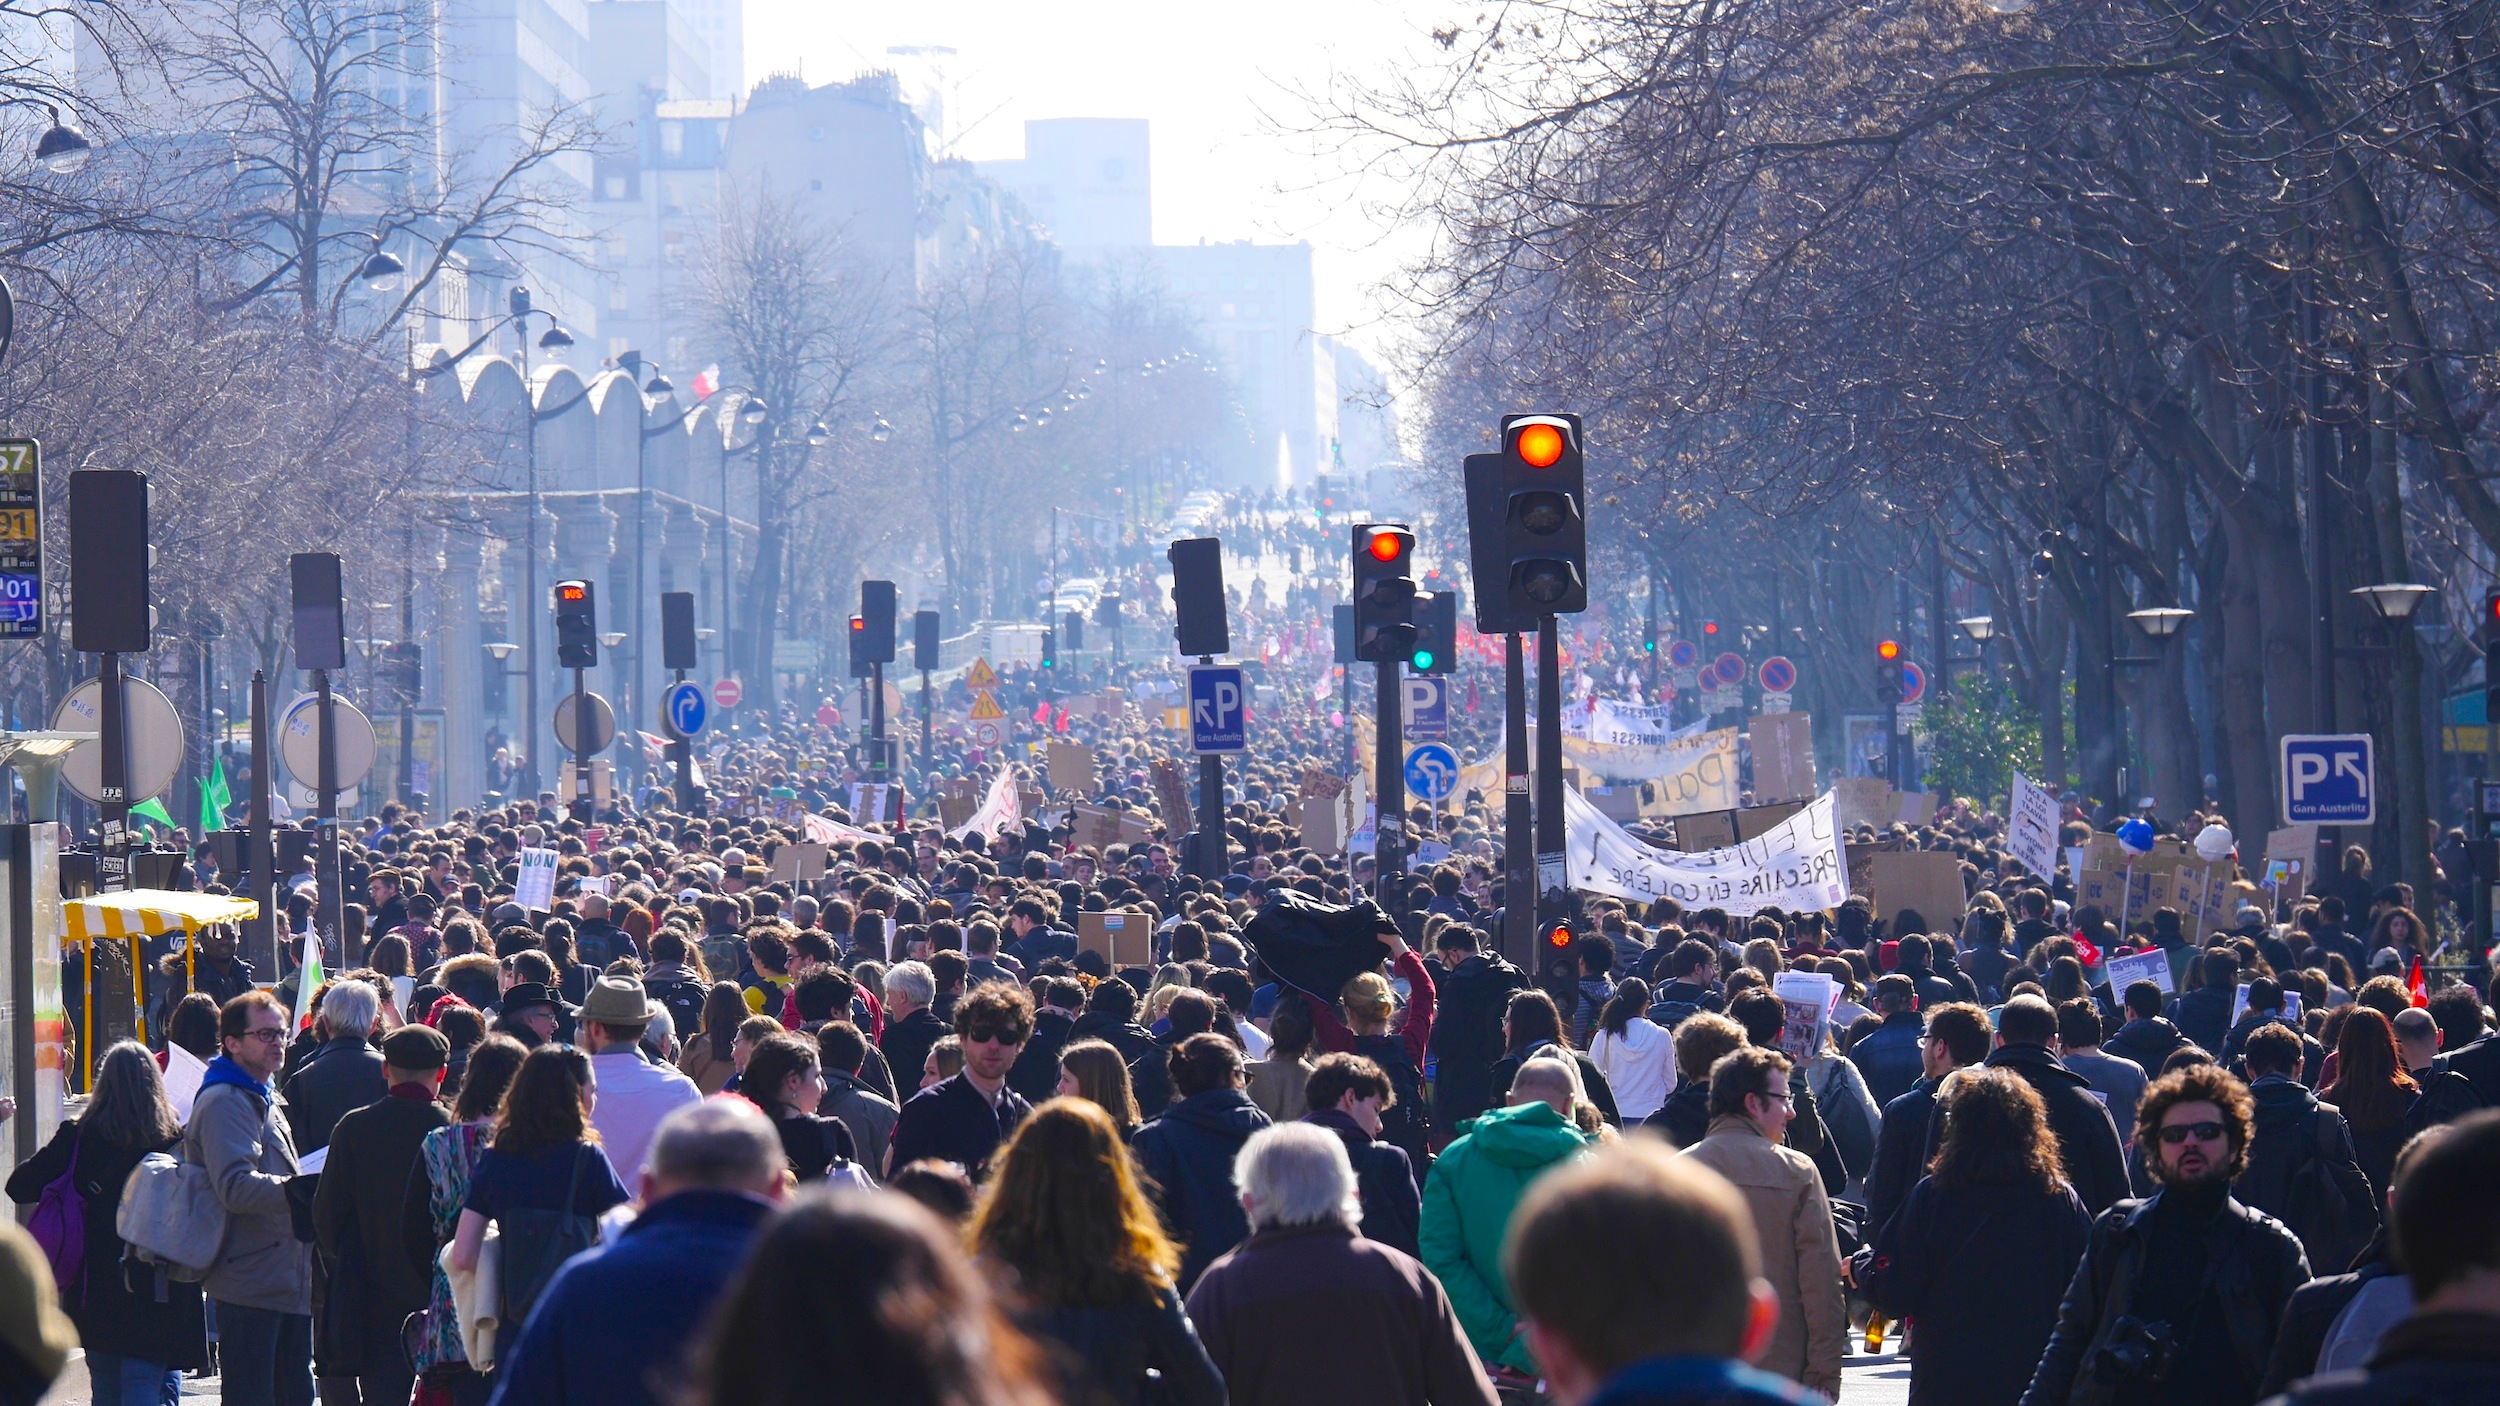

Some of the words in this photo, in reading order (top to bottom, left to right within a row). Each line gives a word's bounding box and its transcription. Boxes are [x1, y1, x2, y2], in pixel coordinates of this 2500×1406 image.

[17, 493, 33, 502] min
[0, 511, 27, 537] 91
[19, 559, 36, 568] min
[564, 588, 583, 600] BUS
[21, 624, 37, 633] min
[1215, 681, 1239, 729] P
[1403, 680, 1438, 725] P
[1196, 734, 1212, 743] Gare
[1213, 732, 1243, 742] Austerlitz
[2292, 752, 2329, 801] P
[2025, 784, 2041, 801] FACE
[2021, 799, 2049, 827] TRAVAIL
[2025, 794, 2034, 805] LA
[2035, 801, 2047, 815] LOI
[2293, 804, 2316, 814] Gare
[2320, 803, 2367, 813] Austerlitz
[1422, 845, 1431, 853] LA
[2019, 828, 2047, 855] SOYONS
[523, 852, 554, 869] NON
[2013, 843, 2048, 876] FLEXIBLES
